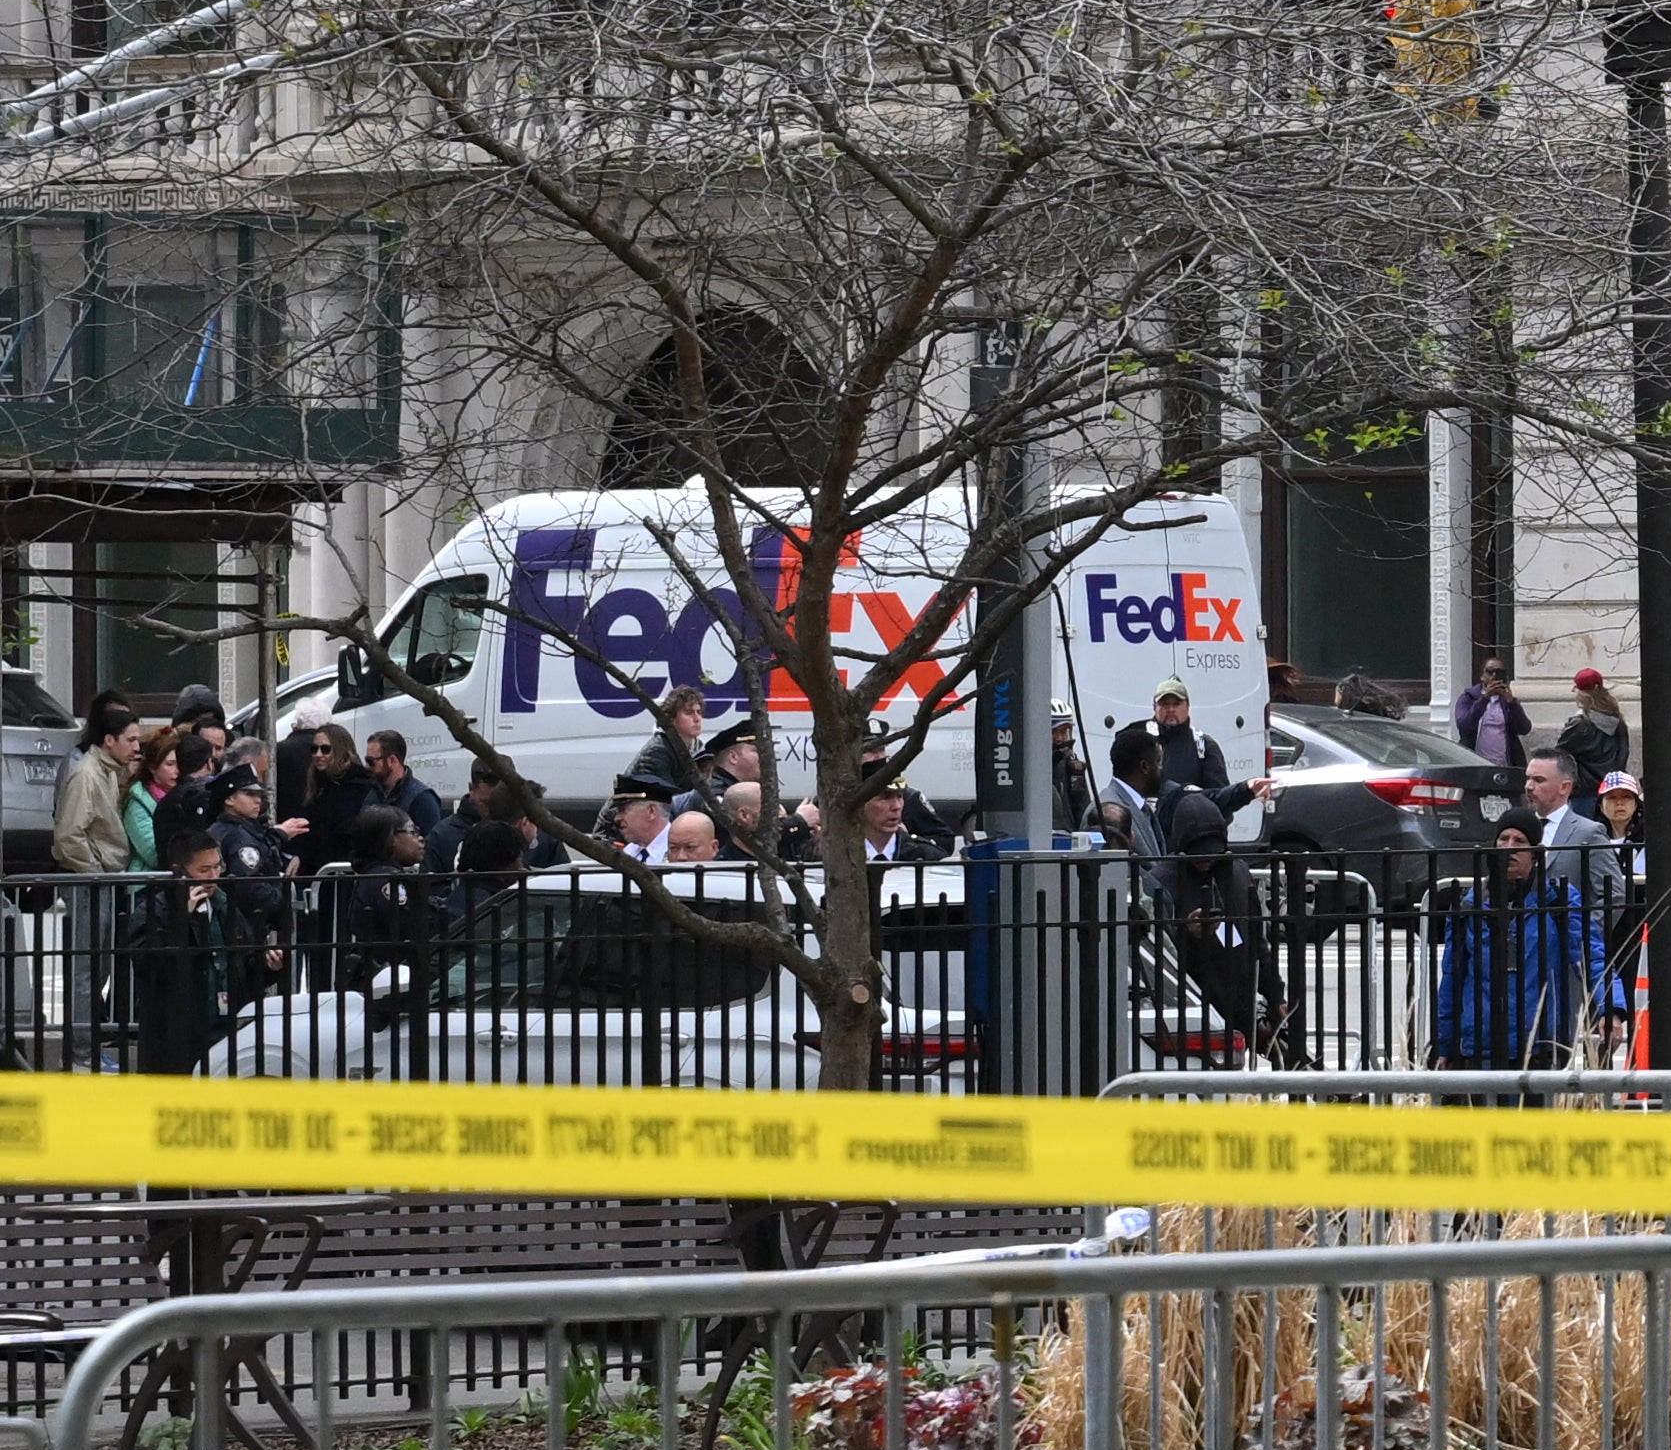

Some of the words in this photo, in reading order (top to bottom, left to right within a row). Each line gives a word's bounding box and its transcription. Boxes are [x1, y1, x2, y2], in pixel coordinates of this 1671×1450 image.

[501, 528, 975, 719] FedEx
[1085, 572, 1245, 644] FedEx
[1186, 648, 1241, 673] Express
